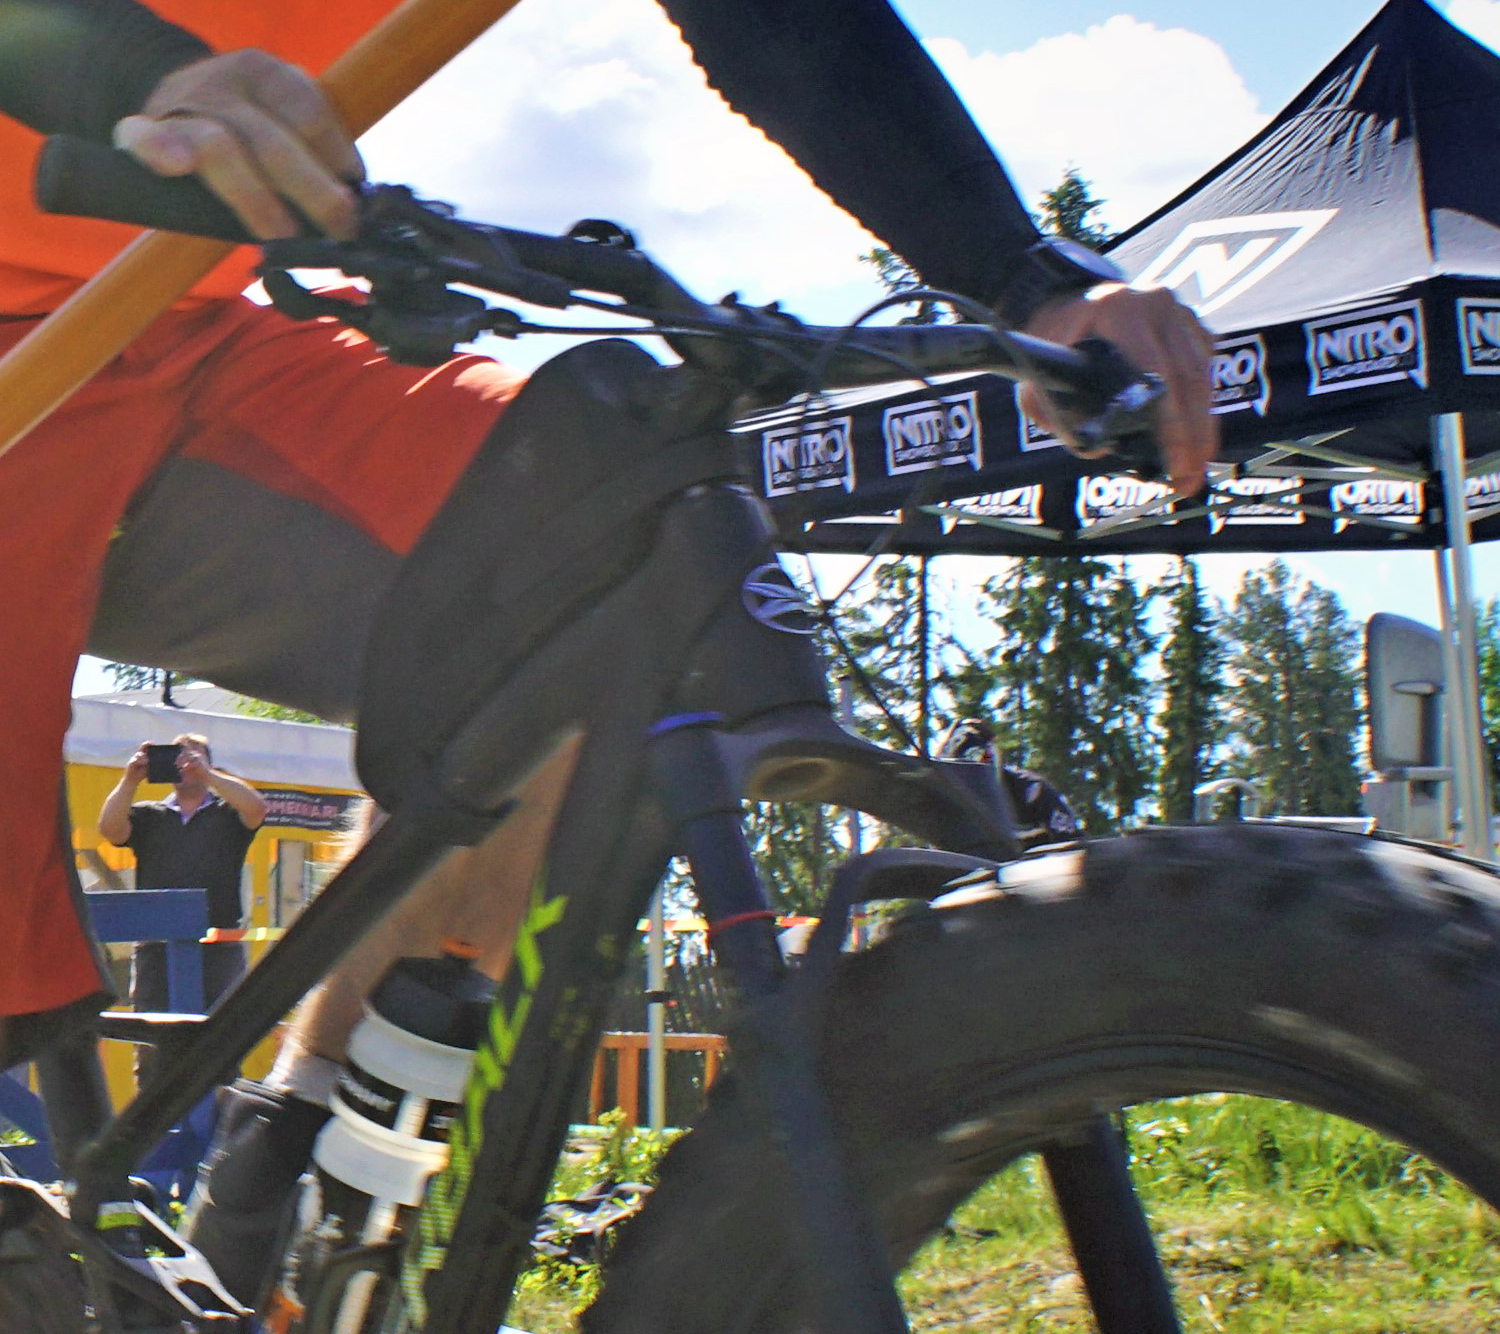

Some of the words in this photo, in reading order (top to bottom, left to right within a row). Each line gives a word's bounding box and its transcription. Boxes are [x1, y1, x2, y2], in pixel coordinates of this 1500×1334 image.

[1316, 315, 1416, 368] NITRO
[890, 404, 973, 450] NITRO
[769, 429, 845, 472] NITRO
